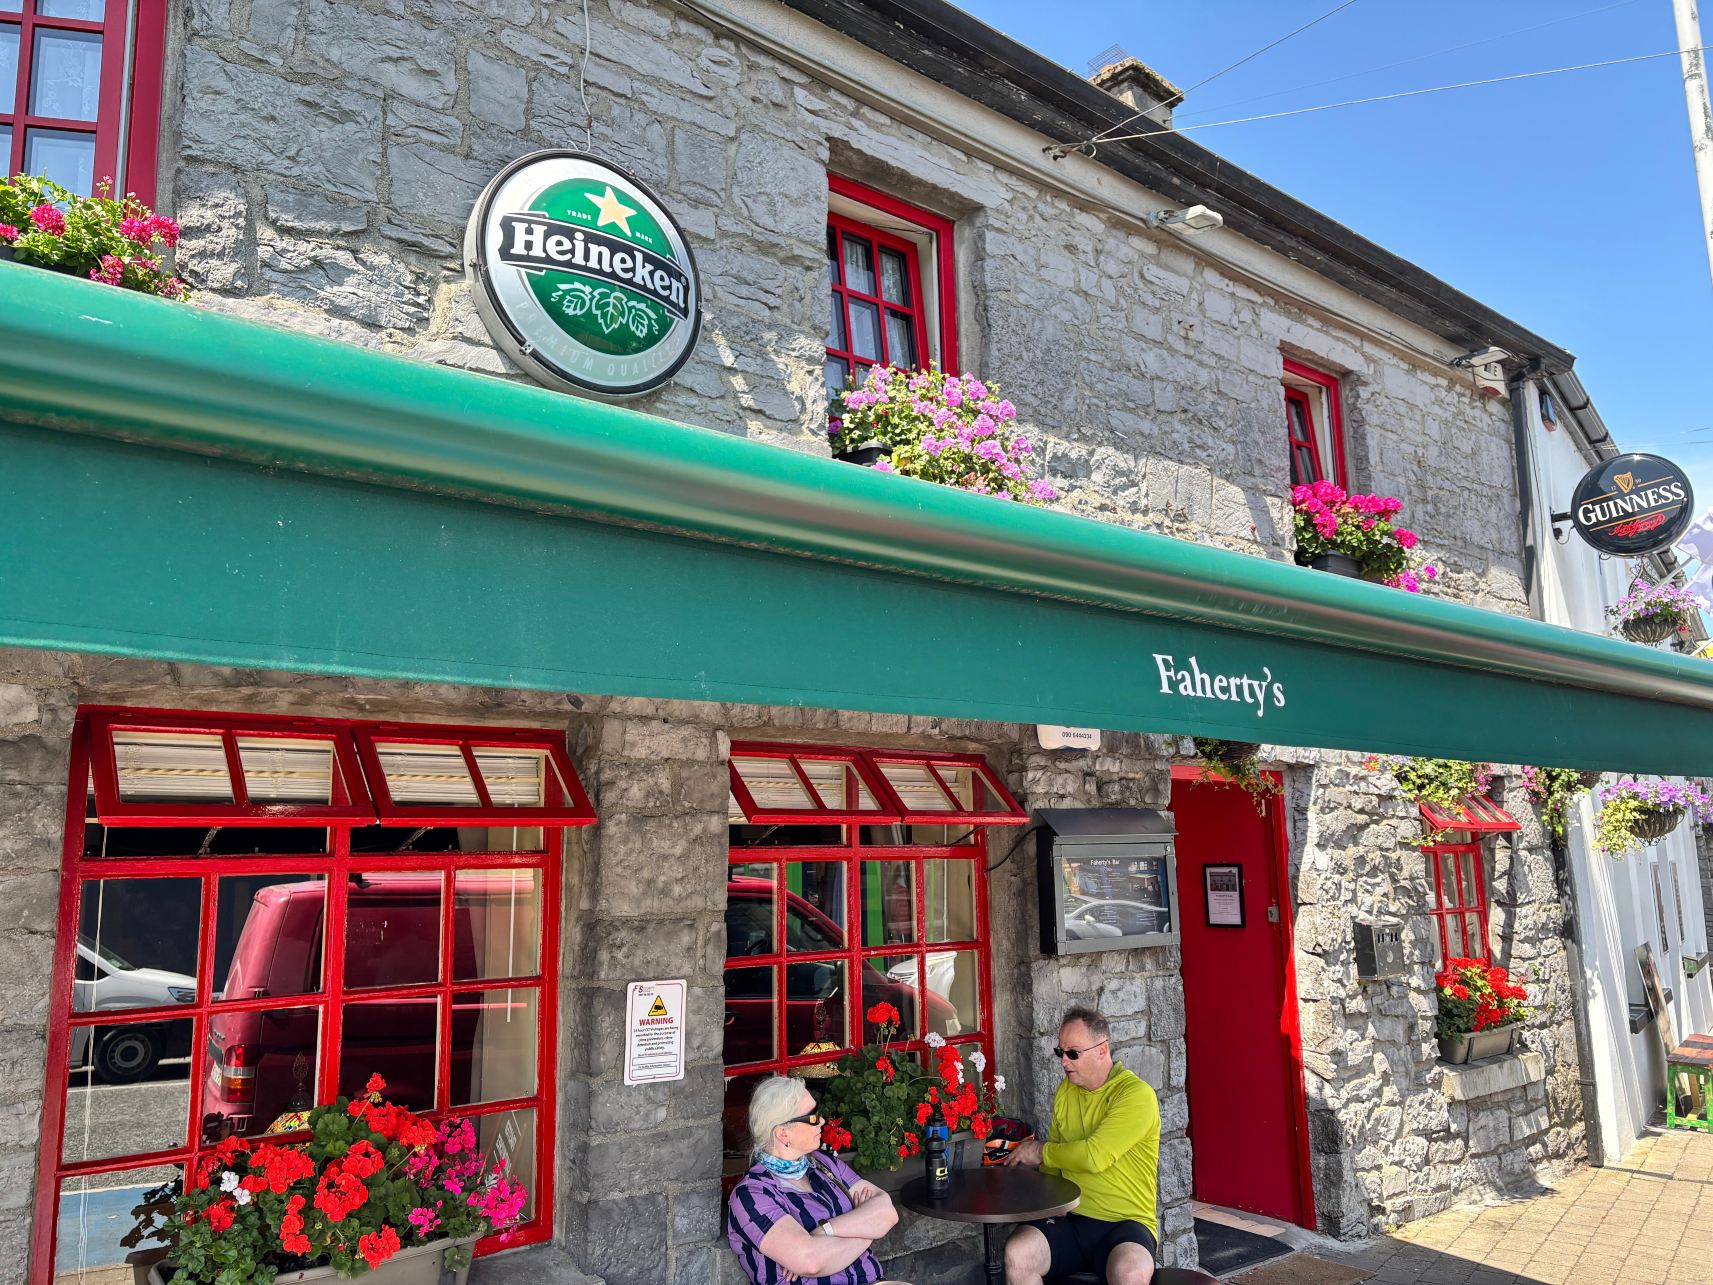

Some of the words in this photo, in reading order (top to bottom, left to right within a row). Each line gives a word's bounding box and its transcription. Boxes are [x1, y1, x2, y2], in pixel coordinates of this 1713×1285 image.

[567, 209, 592, 221] TRADE
[510, 221, 687, 308] Heineken
[1152, 653, 1286, 717] Faherty's
[639, 1017, 674, 1026] WARNING
